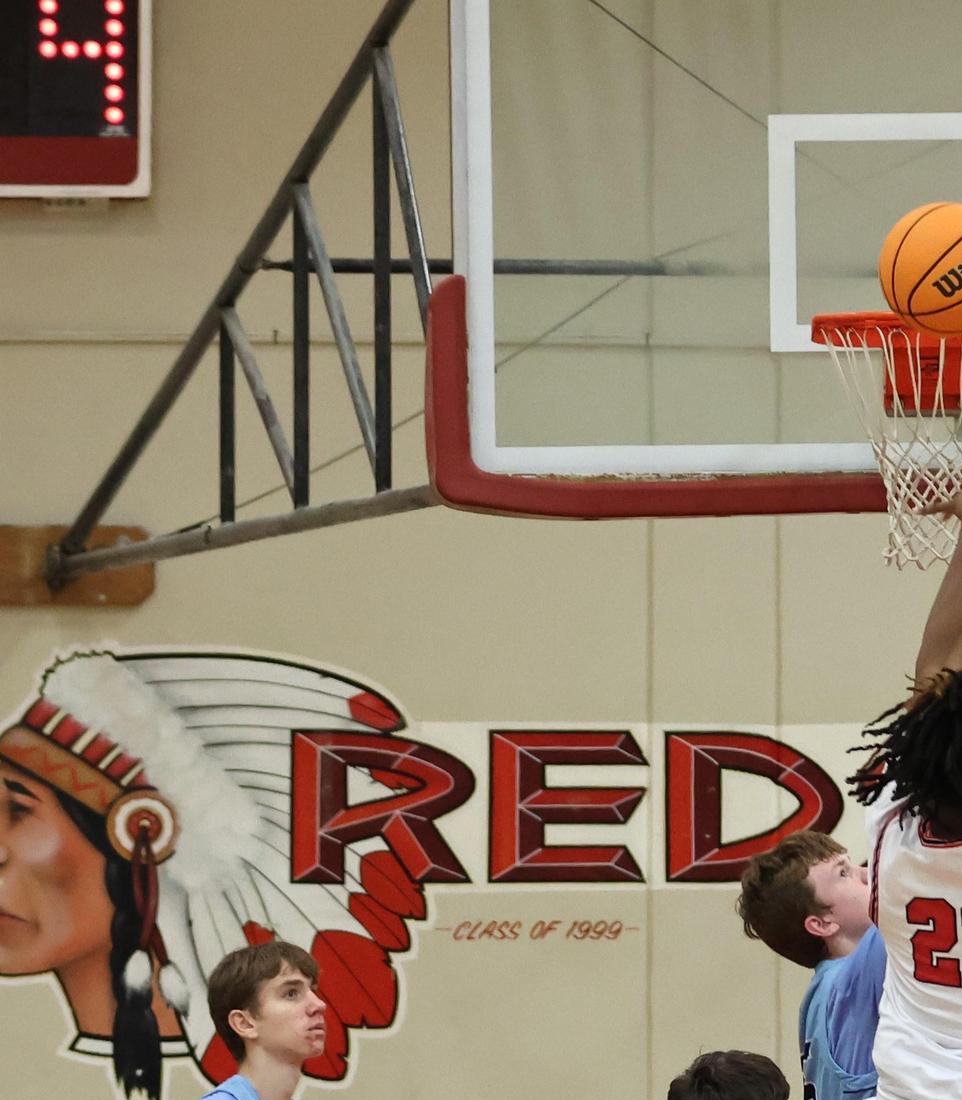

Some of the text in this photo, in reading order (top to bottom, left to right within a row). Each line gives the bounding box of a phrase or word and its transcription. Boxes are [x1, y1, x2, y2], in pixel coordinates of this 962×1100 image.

[453, 920, 623, 941] CLASS OF 1999
